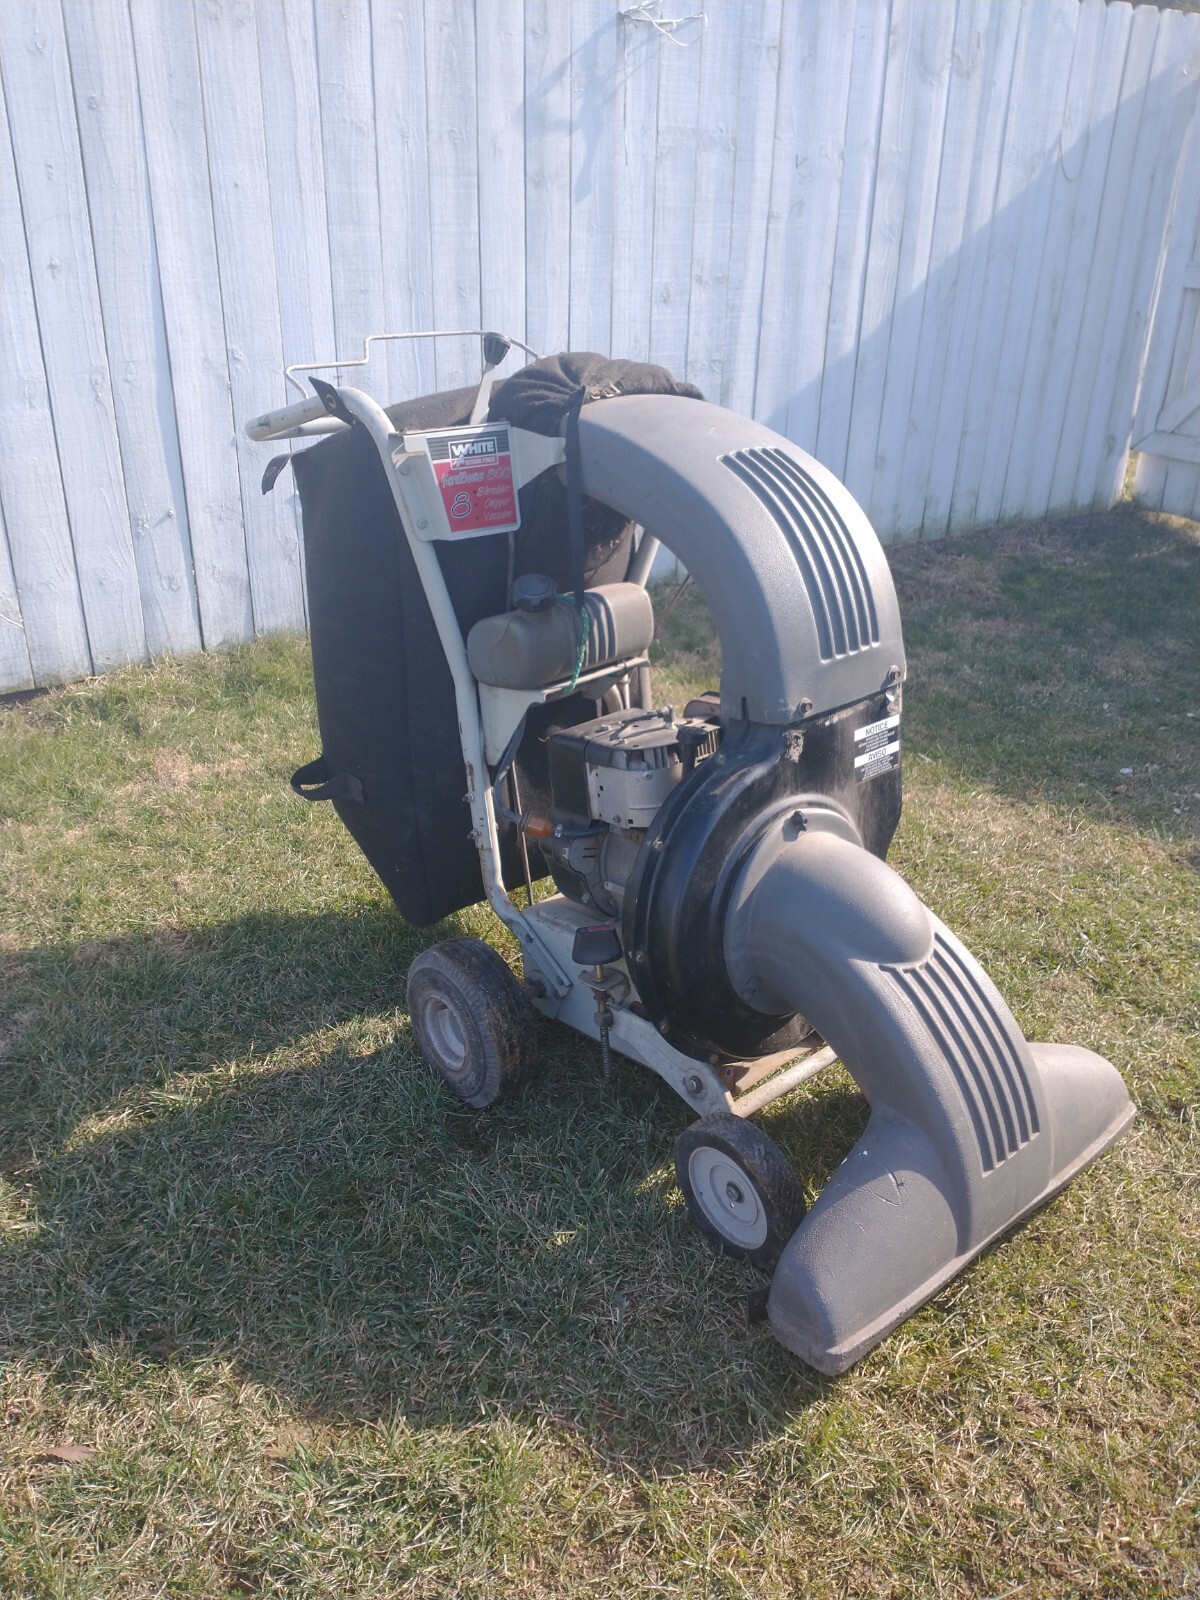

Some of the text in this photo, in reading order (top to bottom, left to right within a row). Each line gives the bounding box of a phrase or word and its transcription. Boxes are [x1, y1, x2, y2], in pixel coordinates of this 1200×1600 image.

[451, 441, 494, 456] WHITE
[476, 484, 511, 497] Shredder
[451, 492, 472, 518] 8
[484, 498, 511, 509] Chipper
[866, 721, 888, 736] NOTICE
[868, 749, 886, 761] AVISO
